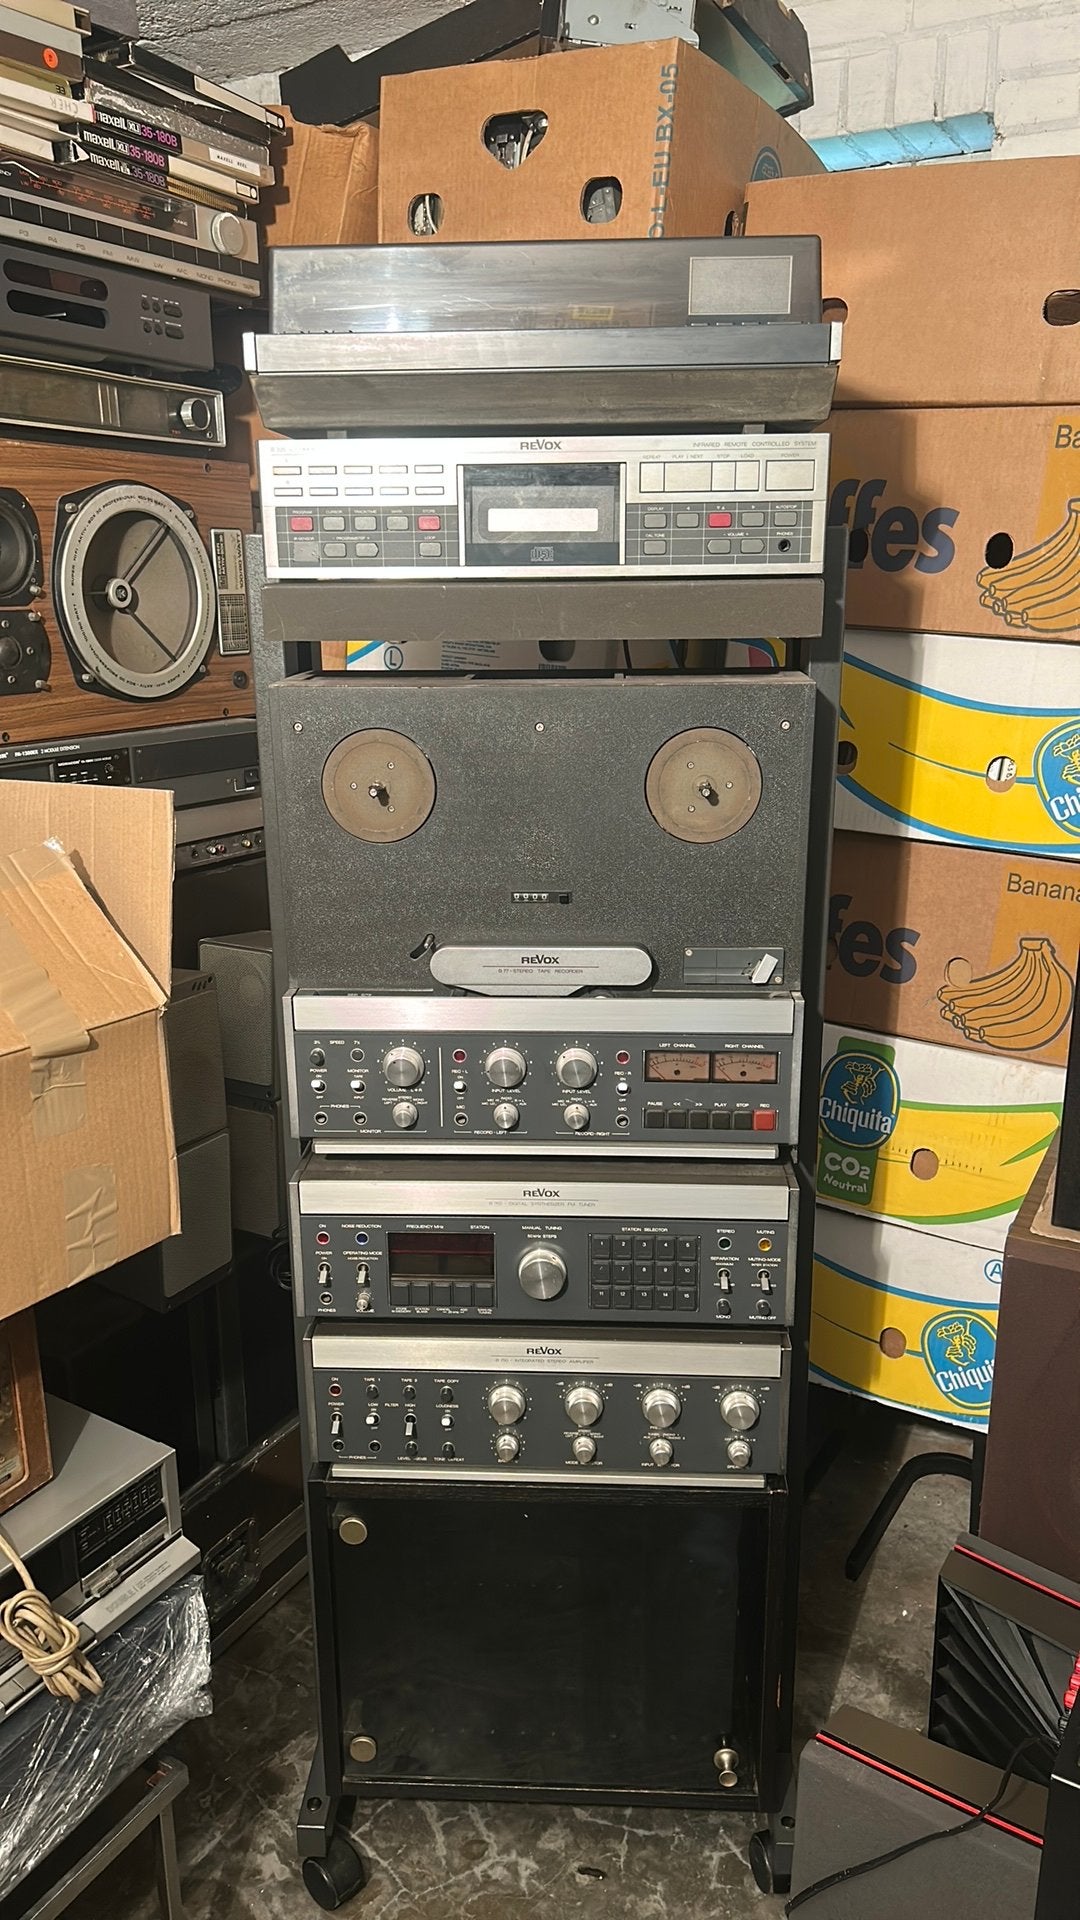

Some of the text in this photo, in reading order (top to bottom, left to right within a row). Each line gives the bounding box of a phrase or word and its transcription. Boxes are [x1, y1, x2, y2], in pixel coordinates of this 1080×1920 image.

[655, 63, 678, 142] BX-05
[83, 130, 165, 168] maxell 35-180B
[141, 124, 178, 147] 35-180B
[90, 152, 166, 187] maxell 35-180B
[819, 1096, 892, 1136] Chiquita
[823, 1172, 867, 1193] Neutral
